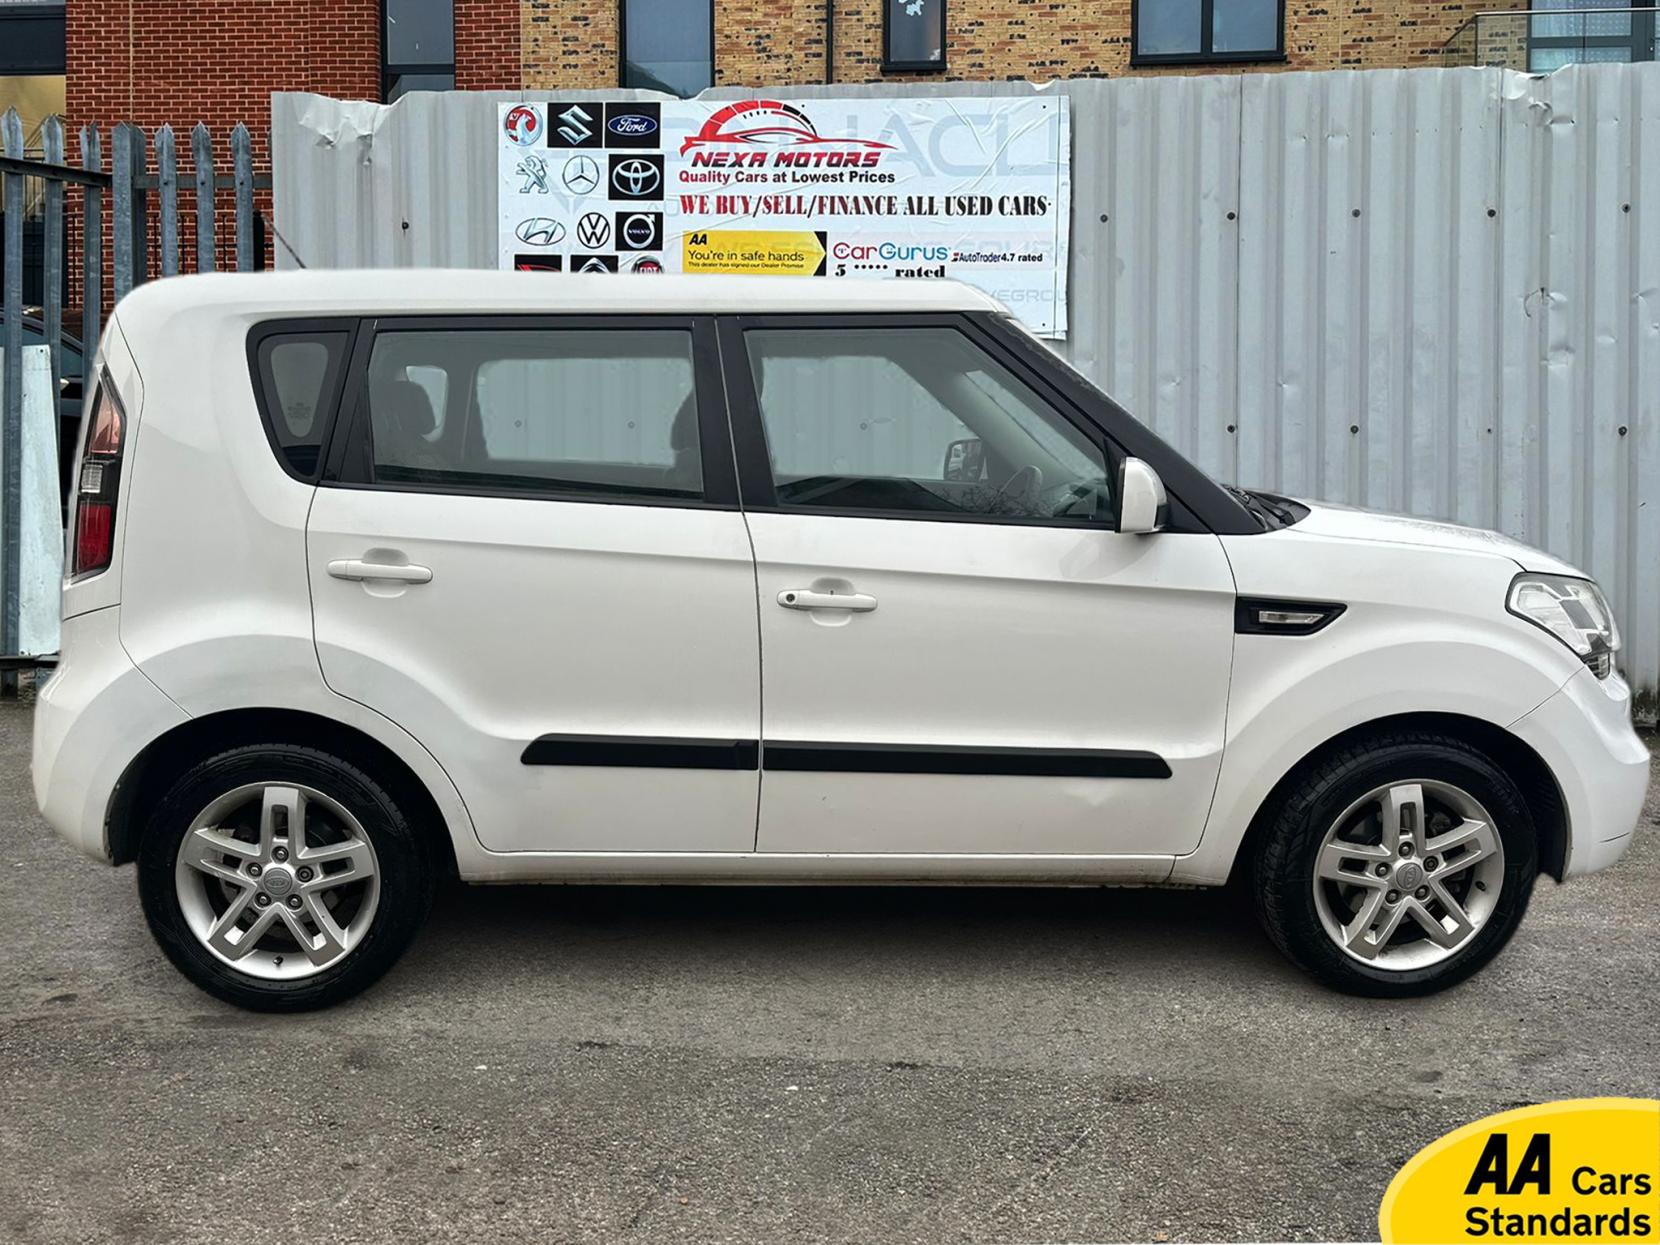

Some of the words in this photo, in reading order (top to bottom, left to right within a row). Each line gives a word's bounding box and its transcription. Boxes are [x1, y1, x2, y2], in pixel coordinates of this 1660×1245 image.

[617, 118, 647, 131] Ford
[692, 152, 768, 167] NEXA
[774, 152, 881, 167] MOTORS
[679, 171, 730, 185] Quality
[735, 171, 768, 182] Cars
[772, 172, 786, 182] at
[792, 171, 845, 182] Lowest
[849, 171, 895, 182] Prices
[680, 195, 709, 215] WE
[716, 195, 898, 217] BUY/SELL/FINANCE
[903, 195, 938, 215] ALL
[945, 195, 993, 215] USED
[689, 234, 707, 245] AA
[688, 250, 724, 260] You're
[727, 251, 737, 260] in
[741, 251, 764, 261] safe
[768, 251, 804, 261] hands
[833, 242, 948, 261] CarGurus
[1018, 254, 1043, 262] rated
[835, 264, 846, 277] 5
[895, 265, 945, 278] rated
